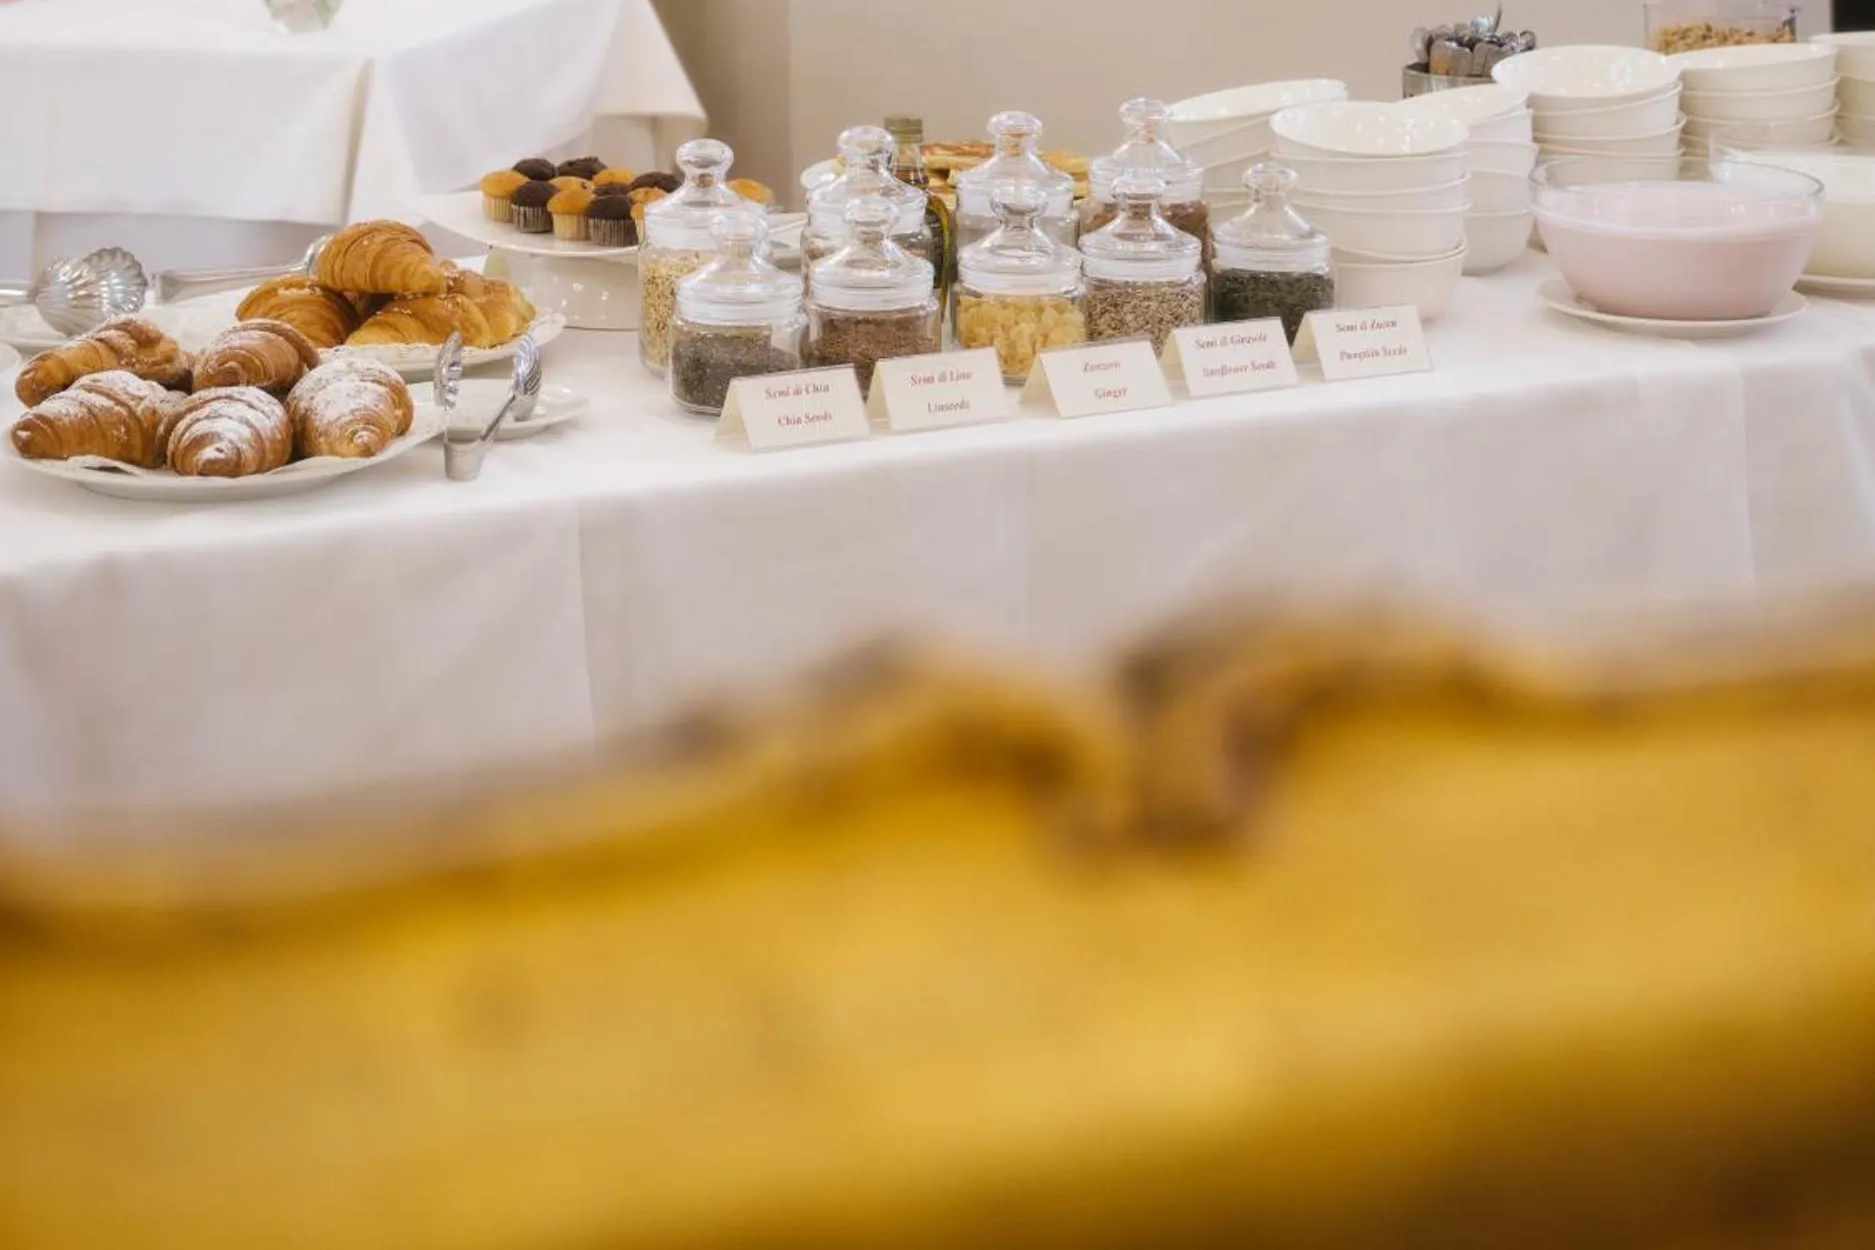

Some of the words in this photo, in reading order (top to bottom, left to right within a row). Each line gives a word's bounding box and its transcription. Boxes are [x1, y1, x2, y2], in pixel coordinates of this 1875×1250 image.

[805, 382, 830, 395] Chia
[777, 414, 803, 427] Chia
[803, 410, 832, 425] Seeds
